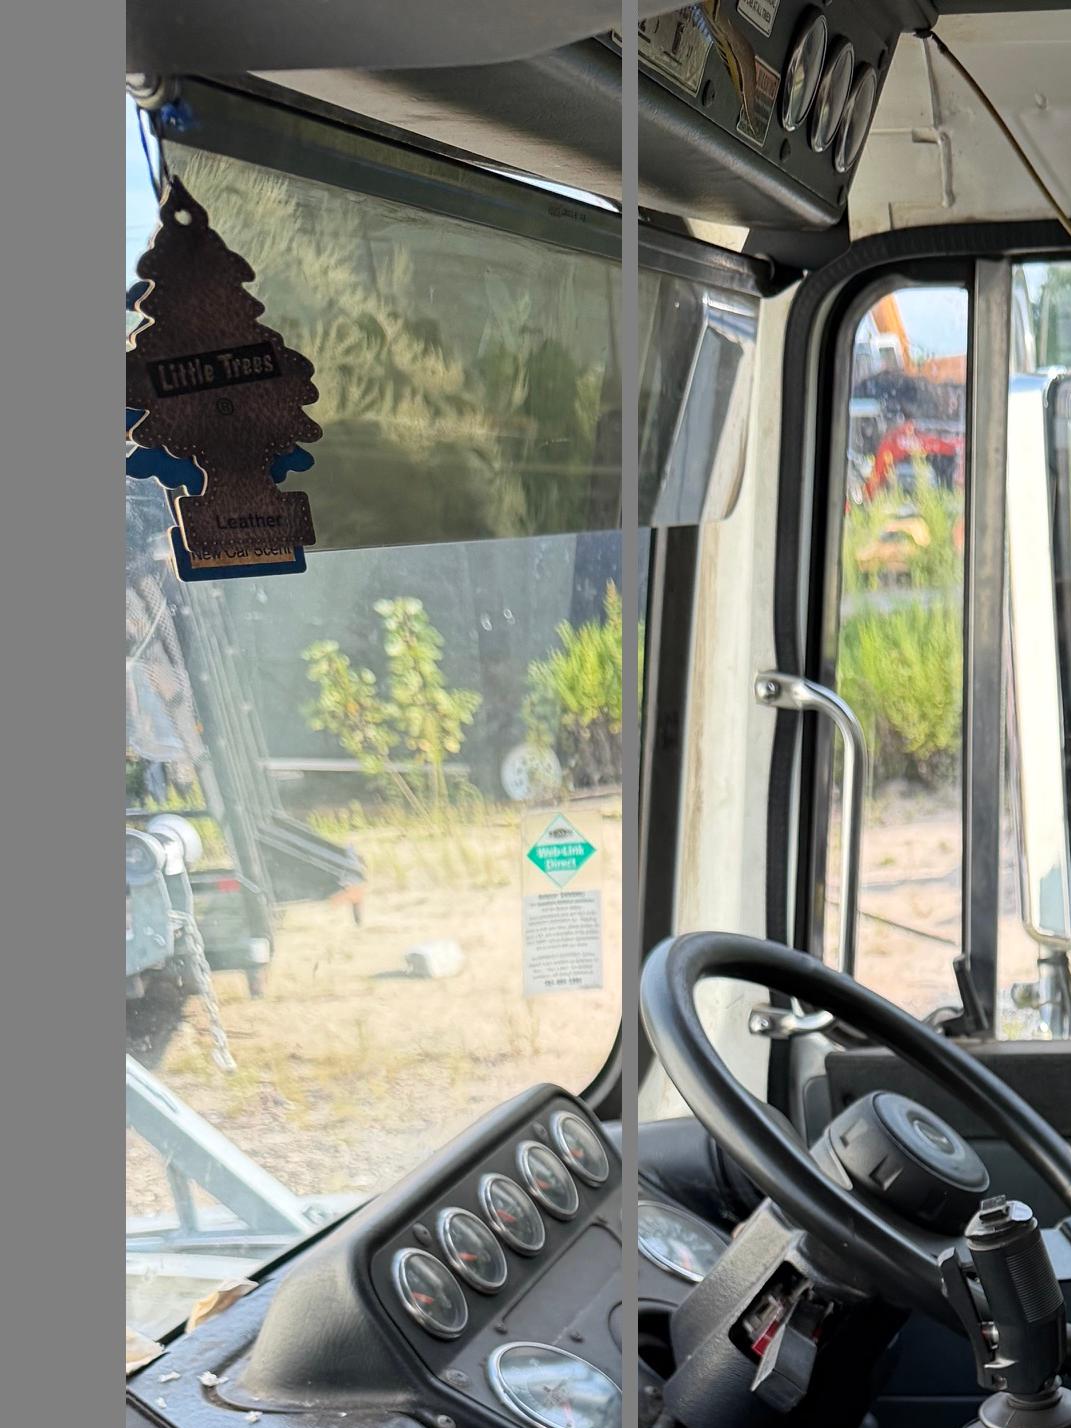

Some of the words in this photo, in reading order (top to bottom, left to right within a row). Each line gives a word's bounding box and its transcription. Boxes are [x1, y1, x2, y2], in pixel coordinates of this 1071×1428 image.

[158, 359, 214, 390] Little
[216, 354, 273, 378] Trees
[216, 513, 285, 530] Leather
[191, 547, 221, 561] New
[225, 547, 249, 558] Car
[254, 545, 293, 556] Scent
